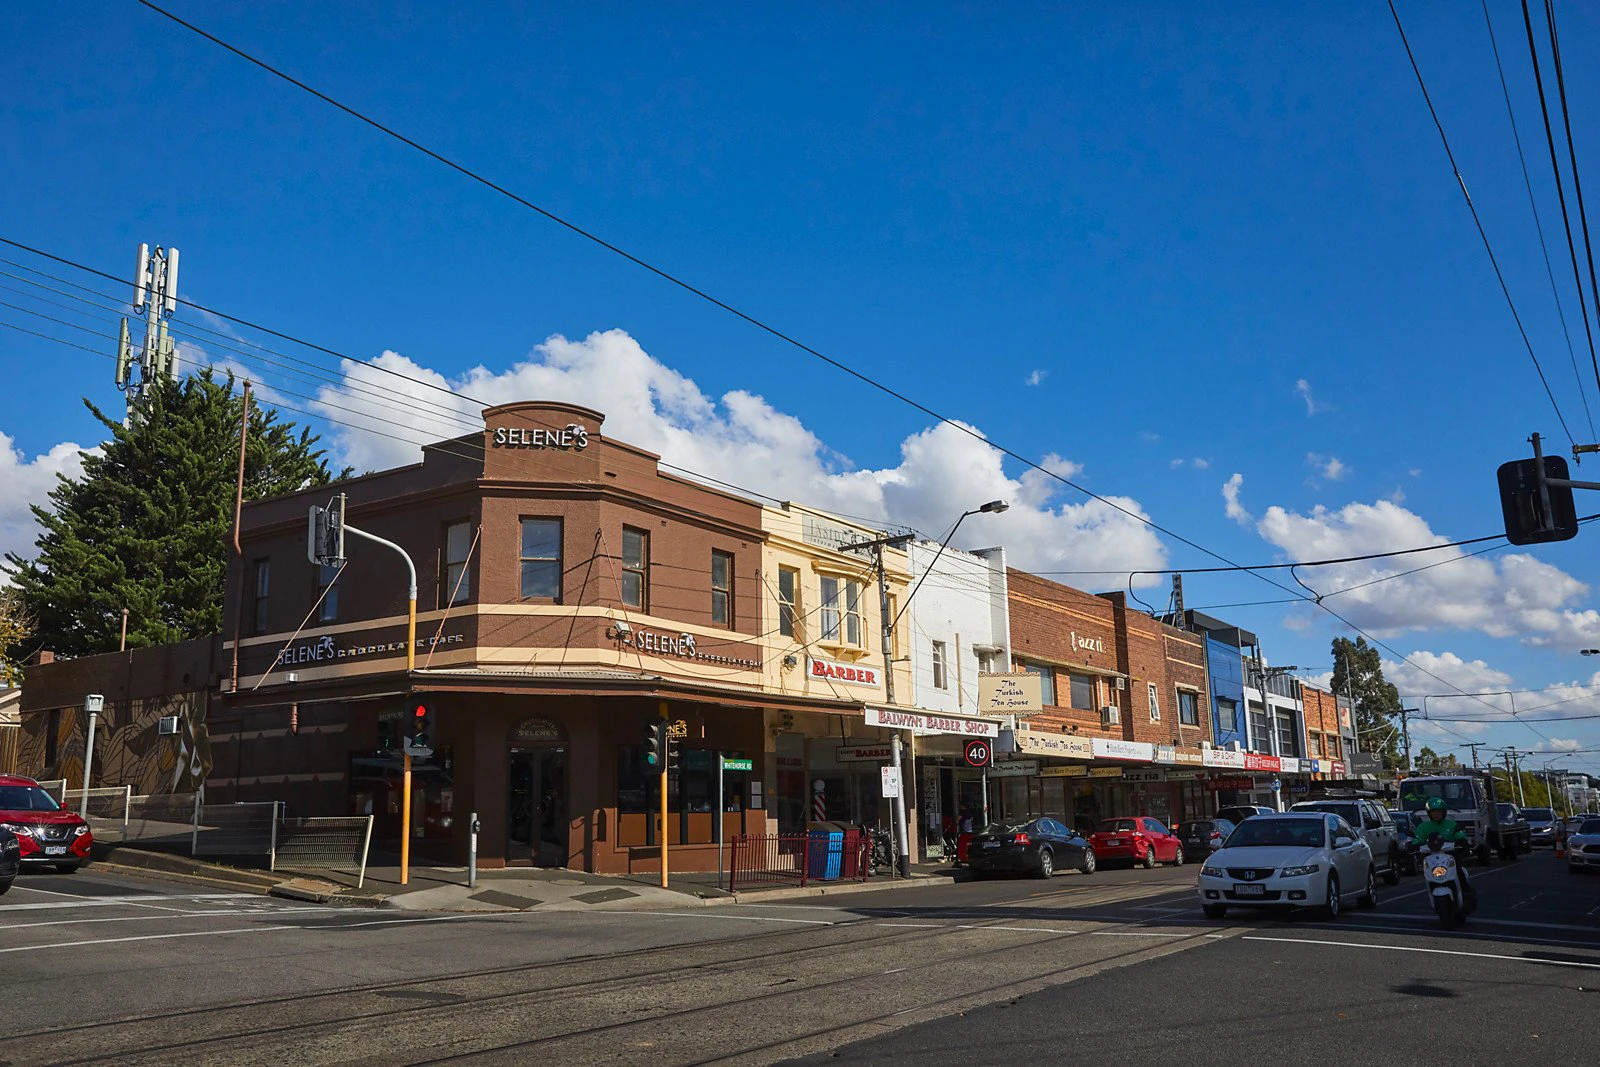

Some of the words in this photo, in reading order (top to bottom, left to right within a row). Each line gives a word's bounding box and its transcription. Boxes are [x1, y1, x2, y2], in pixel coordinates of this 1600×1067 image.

[496, 427, 588, 447] SELENE'S
[278, 642, 334, 665] SELENE'S
[337, 640, 425, 657] CHOCOLAE
[638, 631, 696, 657] SELENE'S
[812, 660, 876, 684] BARBER
[995, 689, 1024, 698] Turkish
[1001, 680, 1016, 688] The
[990, 699, 1005, 707] Tea
[1007, 699, 1029, 707] House
[926, 716, 961, 732] BARBER
[965, 720, 989, 735] SHOP
[969, 747, 986, 759] 40
